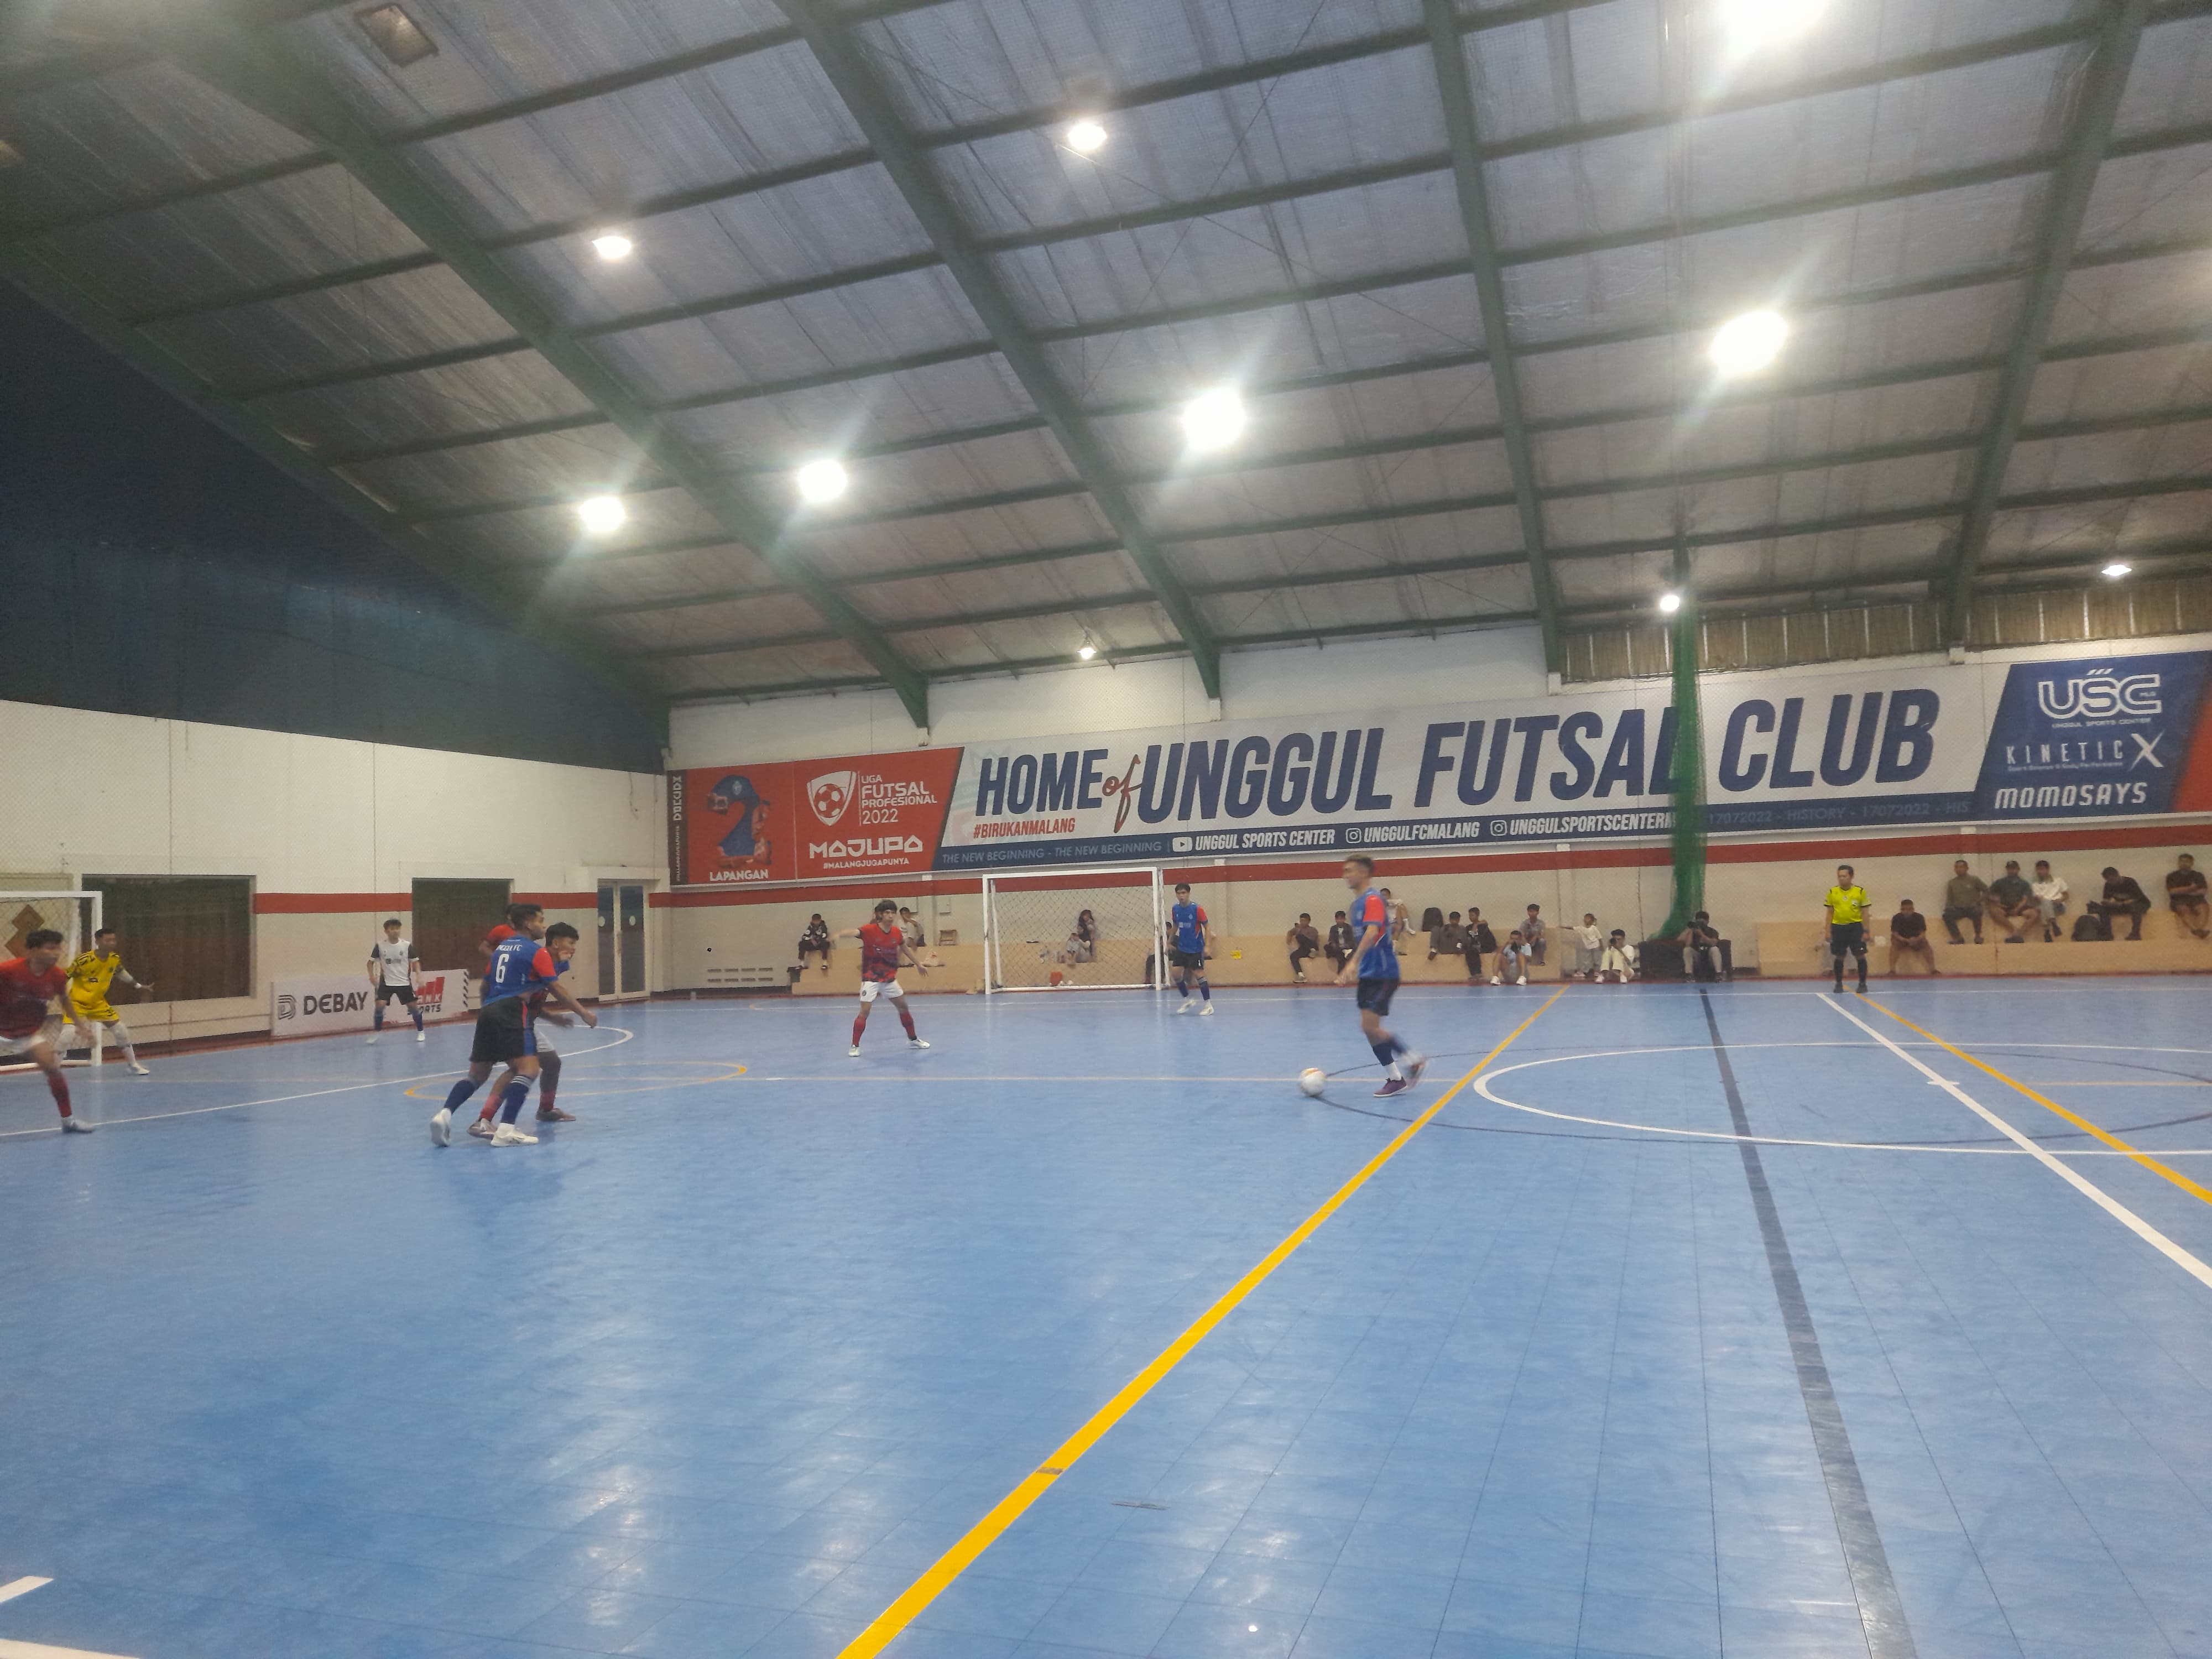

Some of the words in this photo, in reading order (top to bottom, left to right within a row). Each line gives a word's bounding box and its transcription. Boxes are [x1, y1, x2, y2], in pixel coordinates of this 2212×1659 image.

[2038, 674, 2162, 719] USC
[975, 749, 1108, 816] HOME
[1102, 754, 1142, 833] of
[1138, 728, 1392, 824] UNGGUL
[1413, 707, 1684, 807] FUTSAL
[1719, 688, 1940, 792] CLUB
[861, 774, 883, 784] LIGA
[861, 781, 930, 799] FUTSAL
[861, 795, 937, 808] PROFESIONAL
[862, 808, 899, 825] 2022
[973, 817, 1076, 839] #BIRUKANMALANG
[1364, 821, 1480, 843] UNGGULFCMALANG
[1195, 836, 1239, 851] UNGGUL
[1241, 831, 1287, 848] SPORTS
[1289, 829, 1335, 846] CENTER
[823, 858, 910, 869] #MALANGJUGAPUNYA
[942, 853, 959, 864] THE
[962, 852, 985, 862] NEW
[987, 848, 1045, 861] BEGINNING
[1055, 846, 1072, 857] THE
[1074, 844, 1099, 855] NEW
[1101, 842, 1162, 854] BEGINNING
[709, 869, 769, 881] LAPANGAN
[495, 953, 509, 983] 6
[304, 992, 368, 1015] DEBAY
